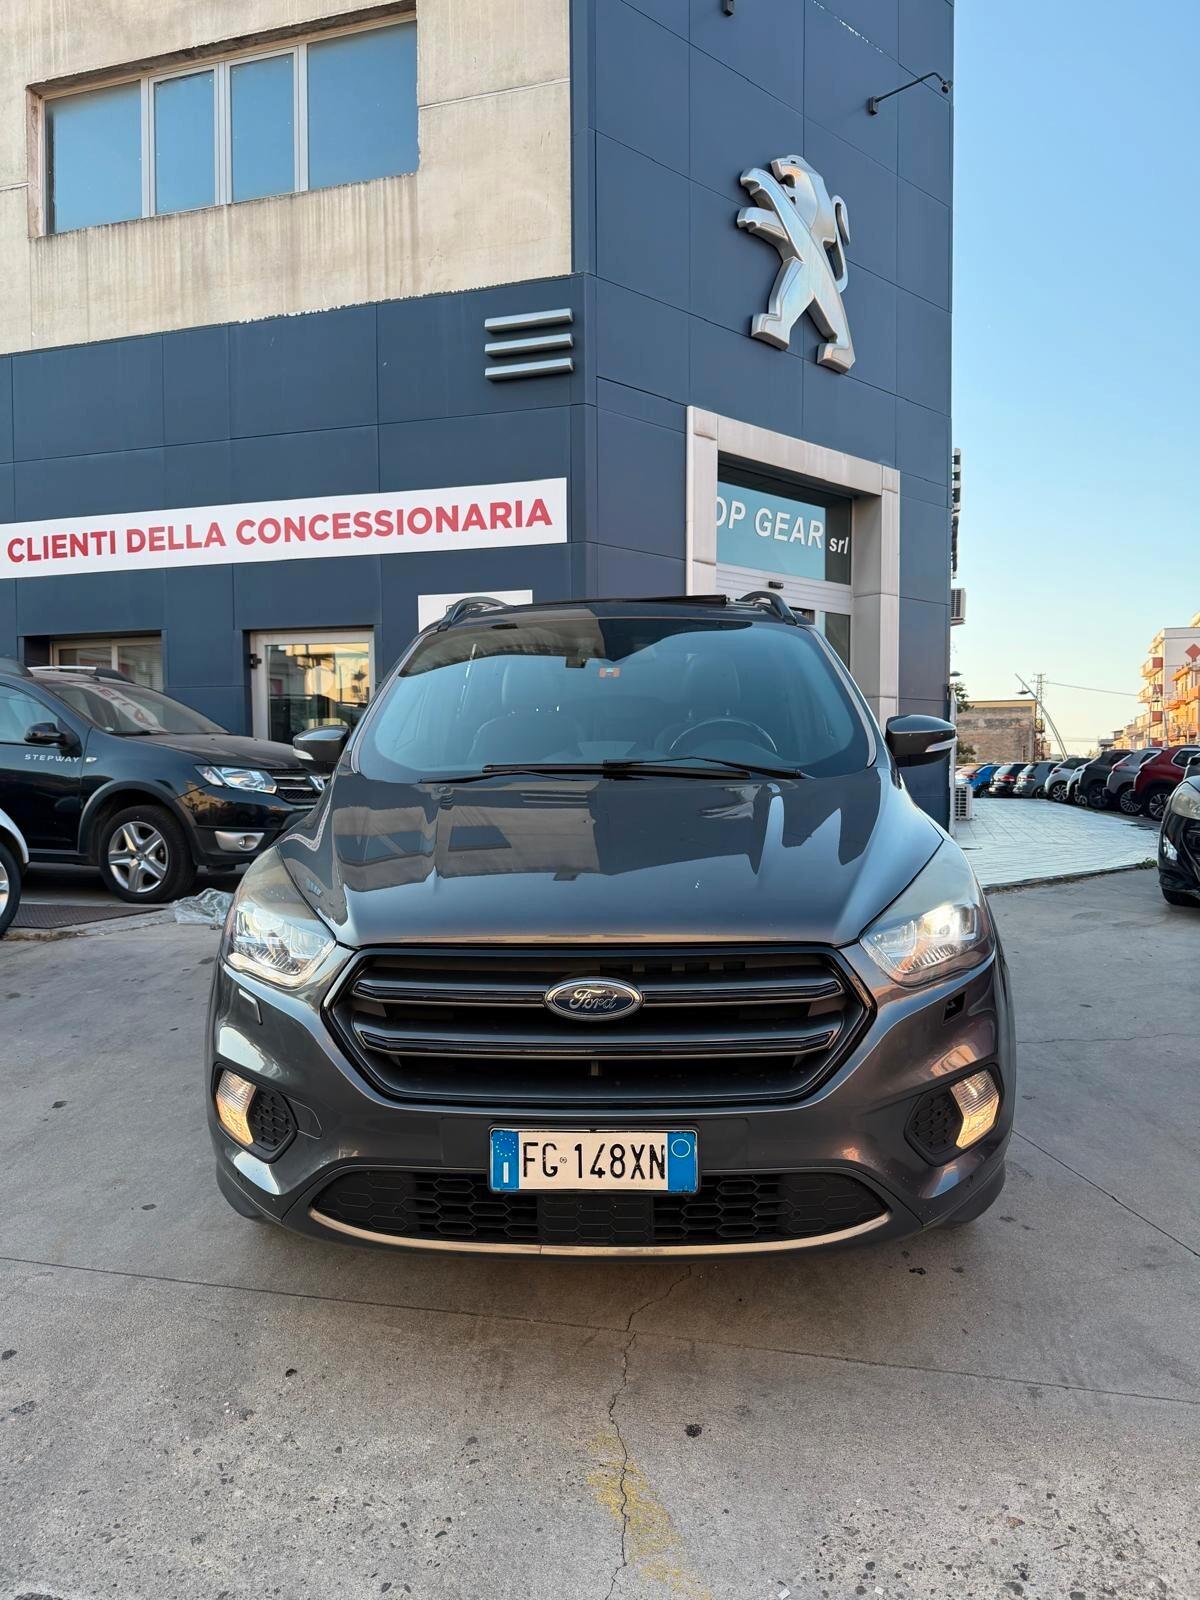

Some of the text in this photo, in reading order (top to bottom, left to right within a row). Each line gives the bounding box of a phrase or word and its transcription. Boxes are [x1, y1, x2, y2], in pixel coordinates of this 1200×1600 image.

[7, 499, 552, 563] CLIENTI DELLA CONCESSIONARIA
[717, 497, 849, 554] OP GEAR srl
[24, 753, 80, 763] STEPWAY
[569, 988, 618, 1009] Ford
[523, 1142, 666, 1180] FG 148XN
